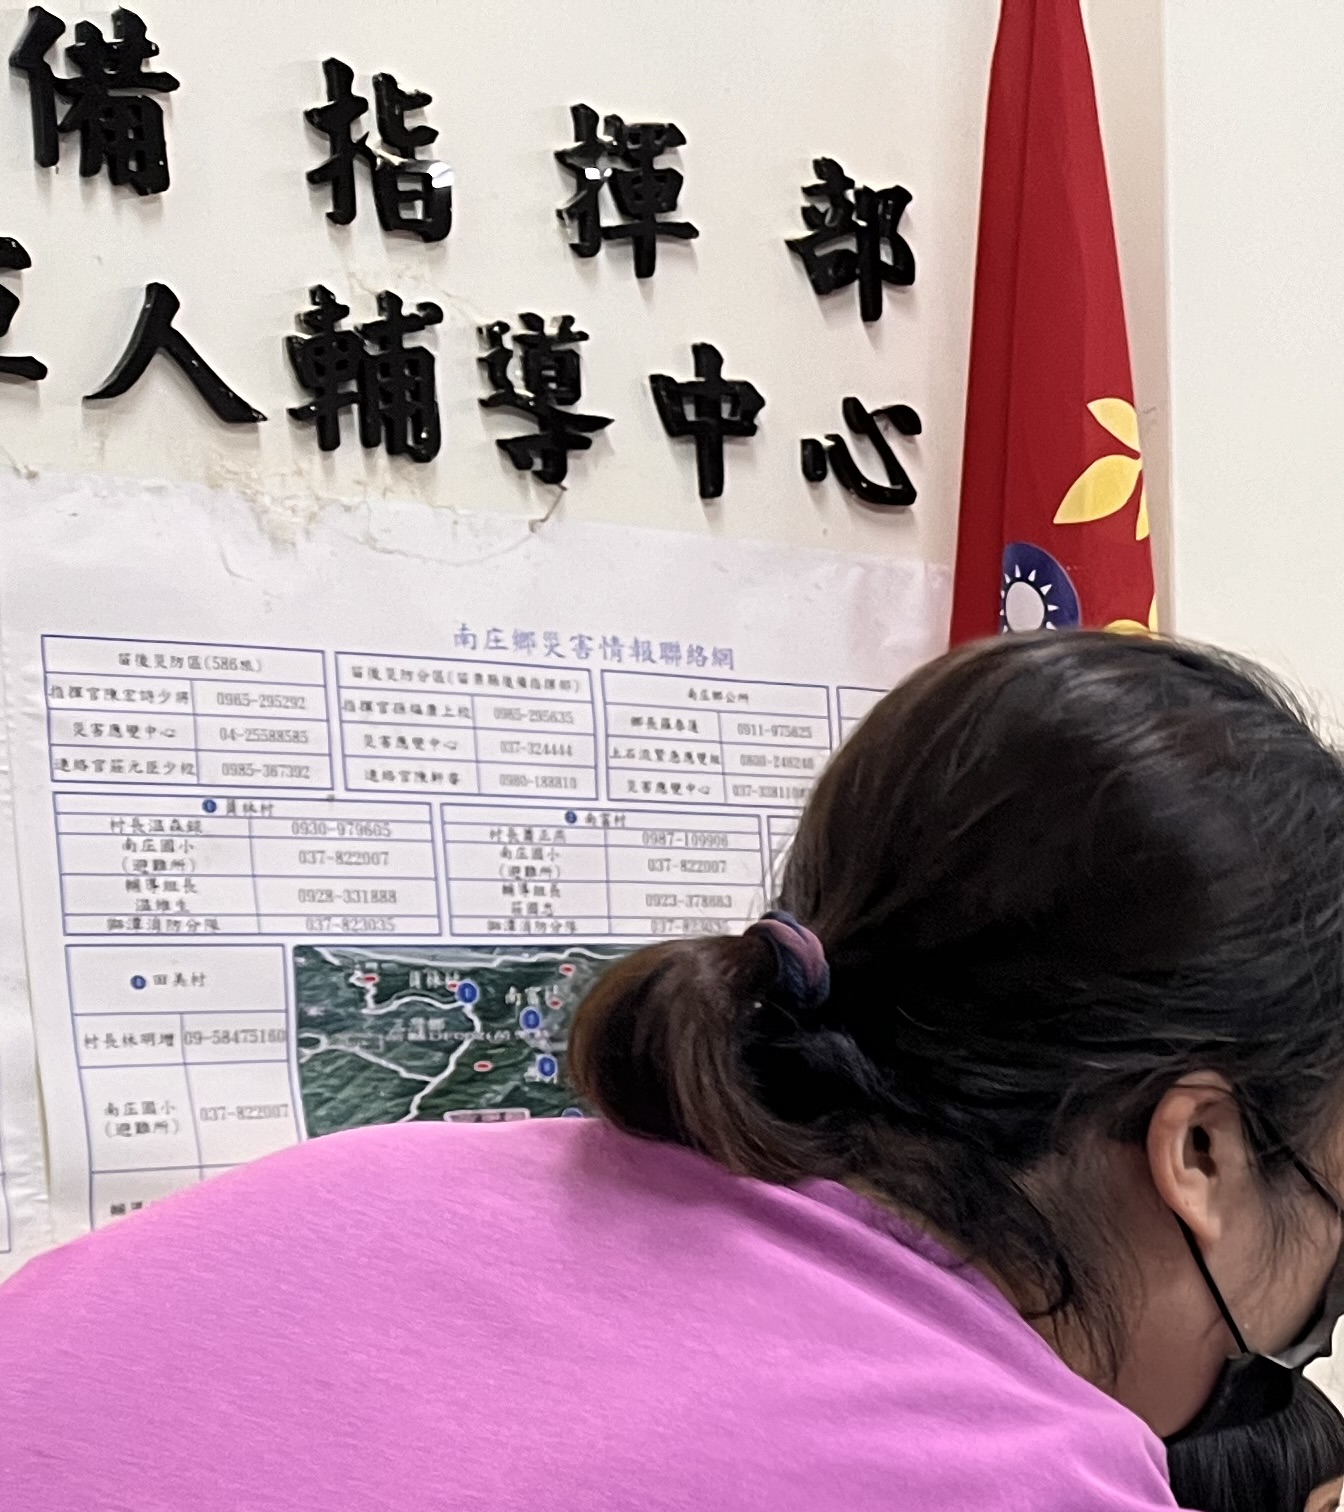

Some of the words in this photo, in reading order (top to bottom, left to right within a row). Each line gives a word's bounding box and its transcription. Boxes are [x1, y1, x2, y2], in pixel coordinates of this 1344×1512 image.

[9, 6, 916, 322] 備指揮部
[454, 623, 734, 670] 南庄鄉災害情報聯絡網
